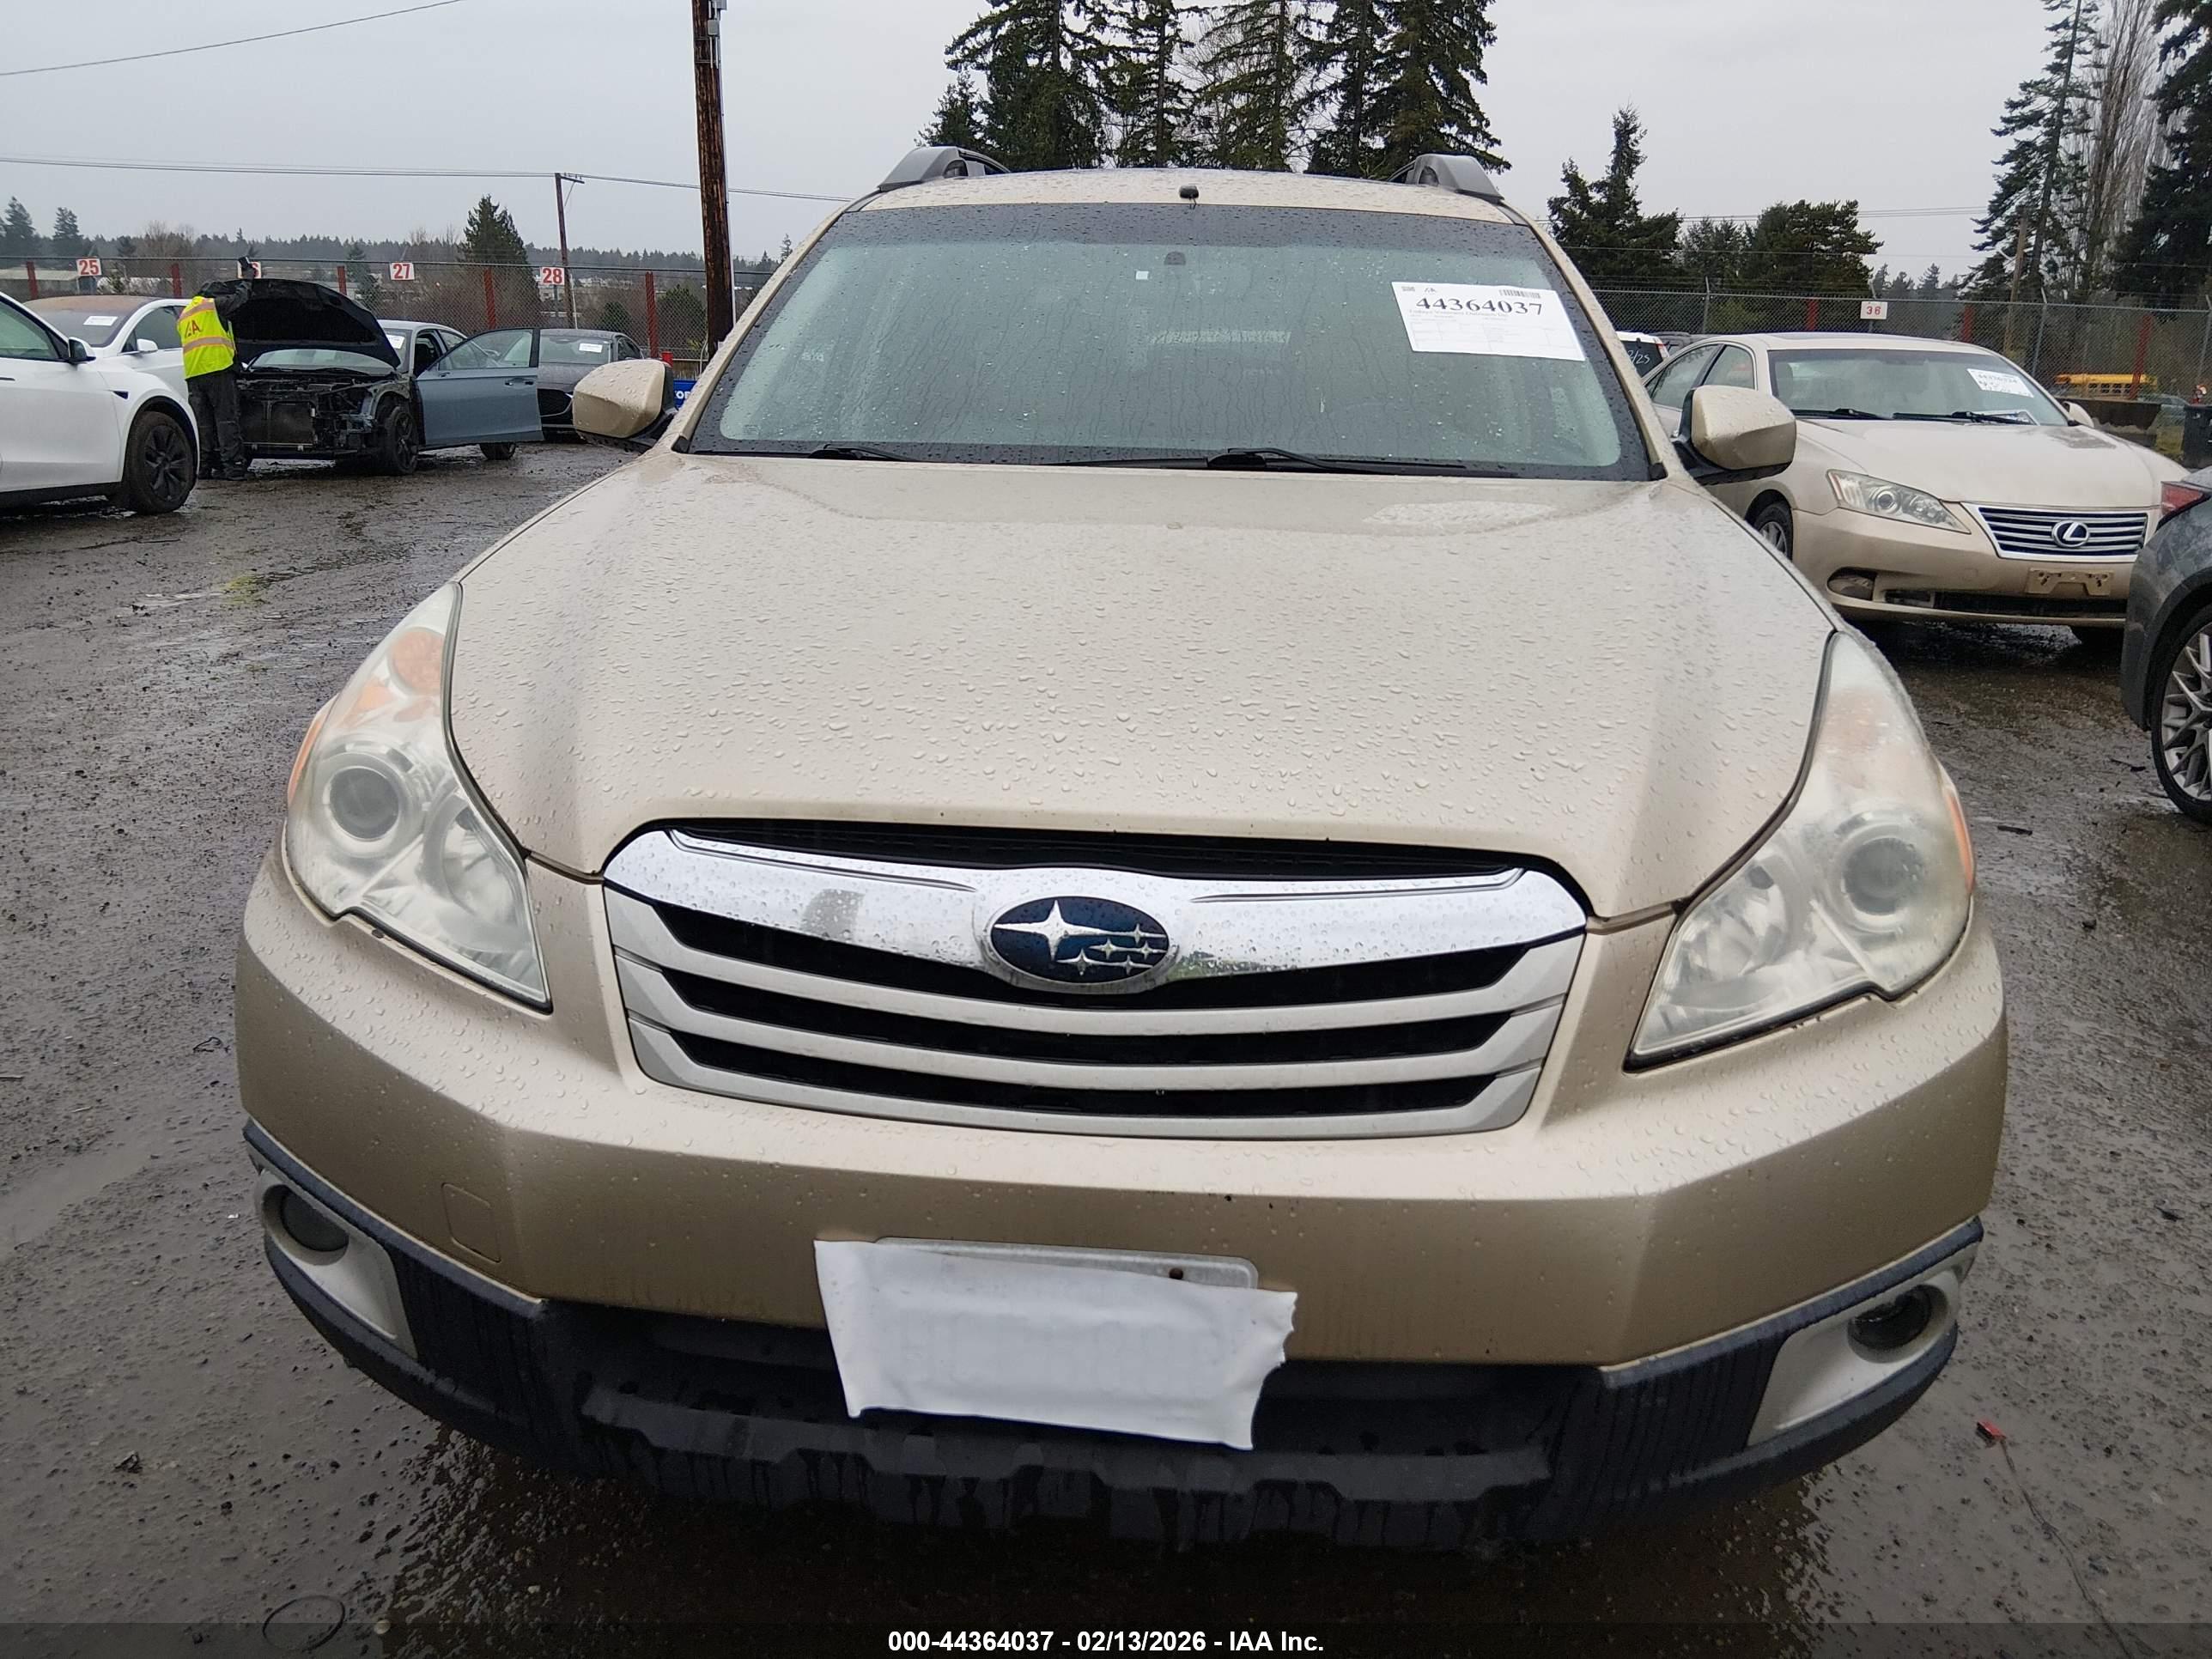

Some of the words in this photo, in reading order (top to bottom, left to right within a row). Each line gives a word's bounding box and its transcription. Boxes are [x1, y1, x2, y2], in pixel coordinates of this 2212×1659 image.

[79, 260, 99, 275] 25
[393, 264, 410, 278] 27
[543, 268, 562, 283] 28
[1416, 297, 1542, 315] 44364037
[1867, 306, 1881, 314] 36
